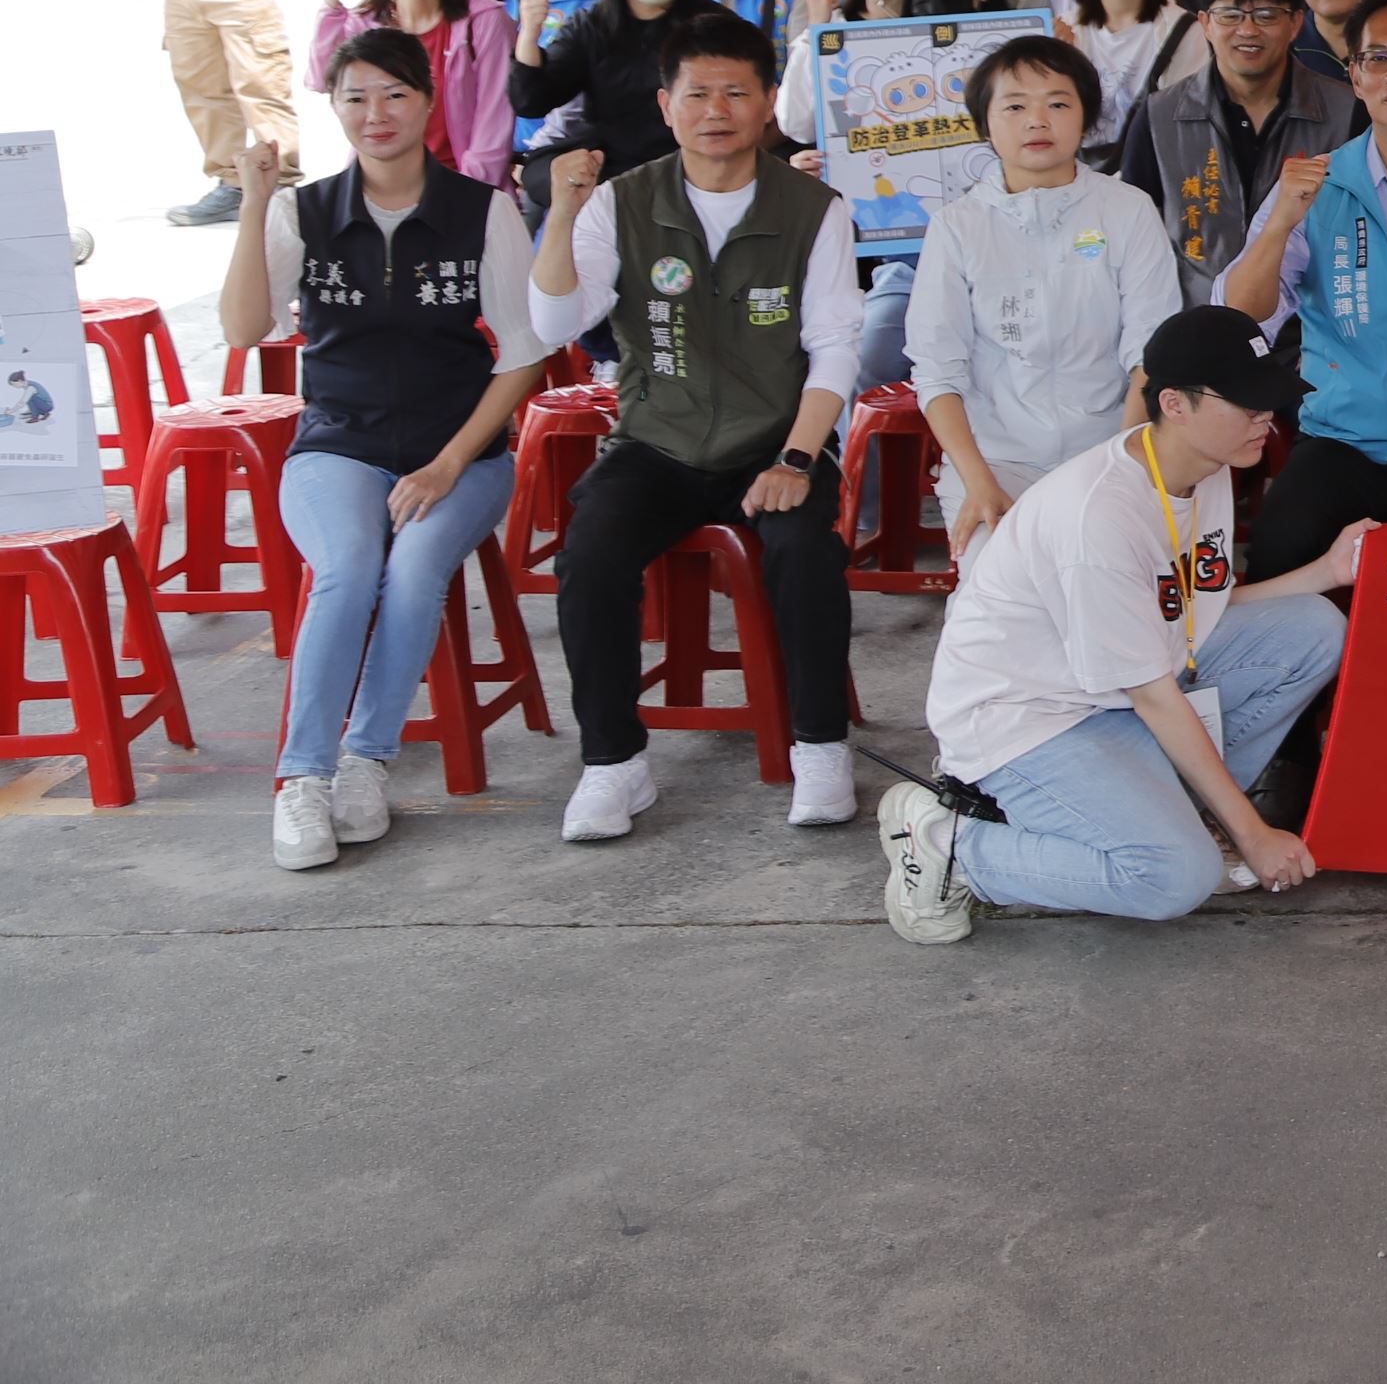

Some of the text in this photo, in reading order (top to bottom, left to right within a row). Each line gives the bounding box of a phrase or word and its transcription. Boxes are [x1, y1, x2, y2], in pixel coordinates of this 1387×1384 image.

[852, 114, 972, 147] 防治登革熱大
